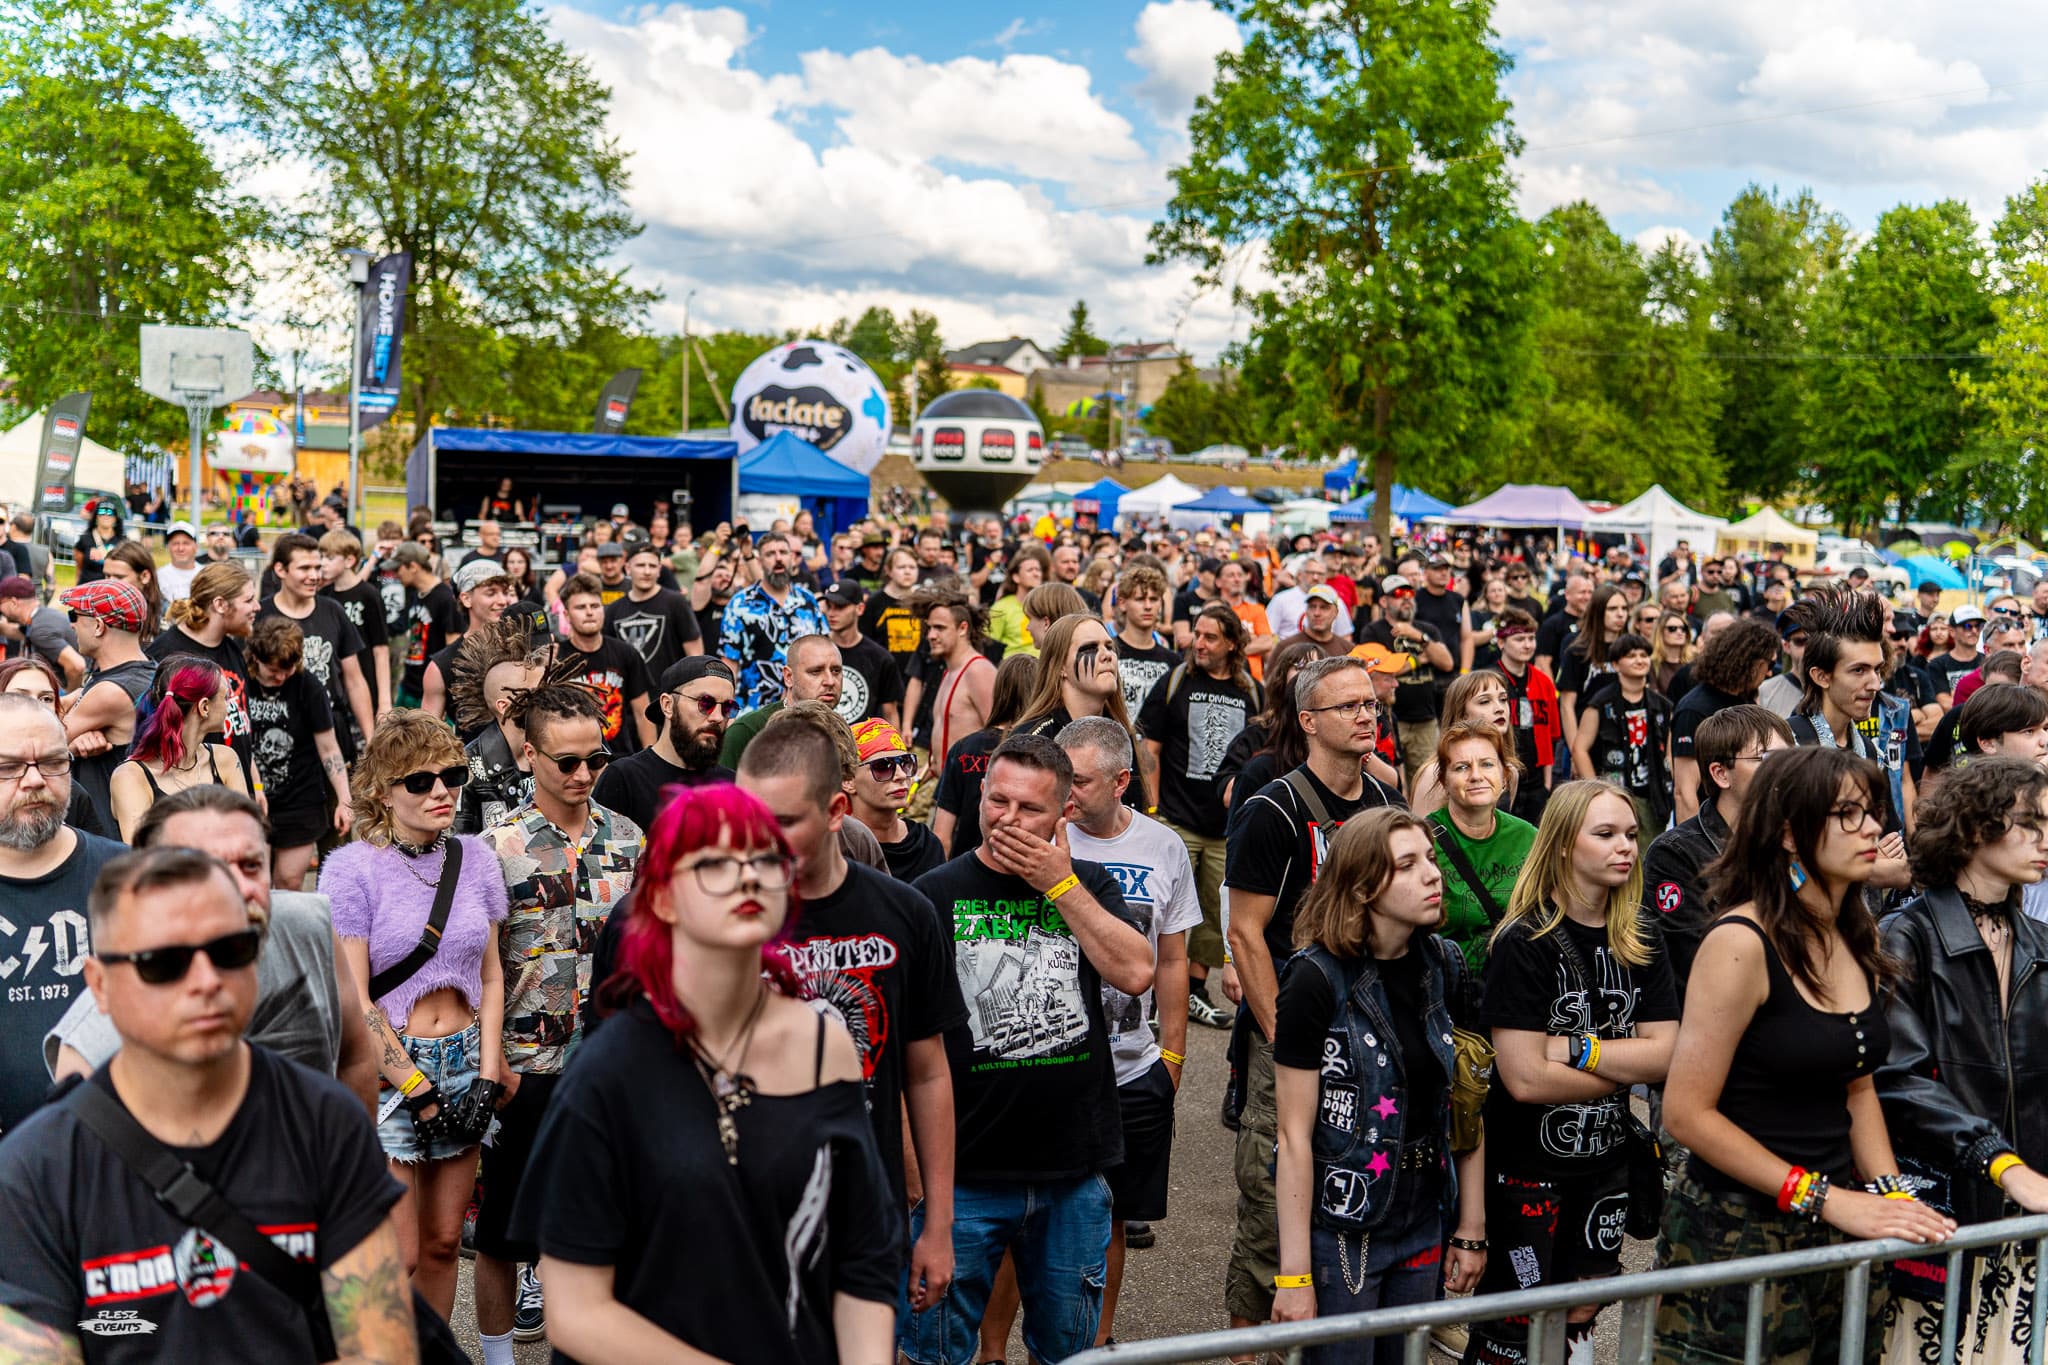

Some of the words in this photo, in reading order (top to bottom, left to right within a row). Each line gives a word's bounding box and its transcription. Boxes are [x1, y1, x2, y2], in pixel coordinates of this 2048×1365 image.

[374, 272, 397, 385] HOMENET
[1189, 692, 1207, 702] JOY
[1208, 693, 1246, 709] DIVISION
[952, 899, 1038, 917] ZIELONE
[776, 935, 897, 979] PLOITED
[1054, 950, 1072, 961] DOM
[8, 985, 36, 1002] EST.
[39, 983, 69, 1000] 1973
[978, 1060, 1018, 1072] KULTURA
[1020, 1058, 1033, 1067] TU
[1325, 1089, 1356, 1105] BOYS
[1328, 1112, 1354, 1130] CRY
